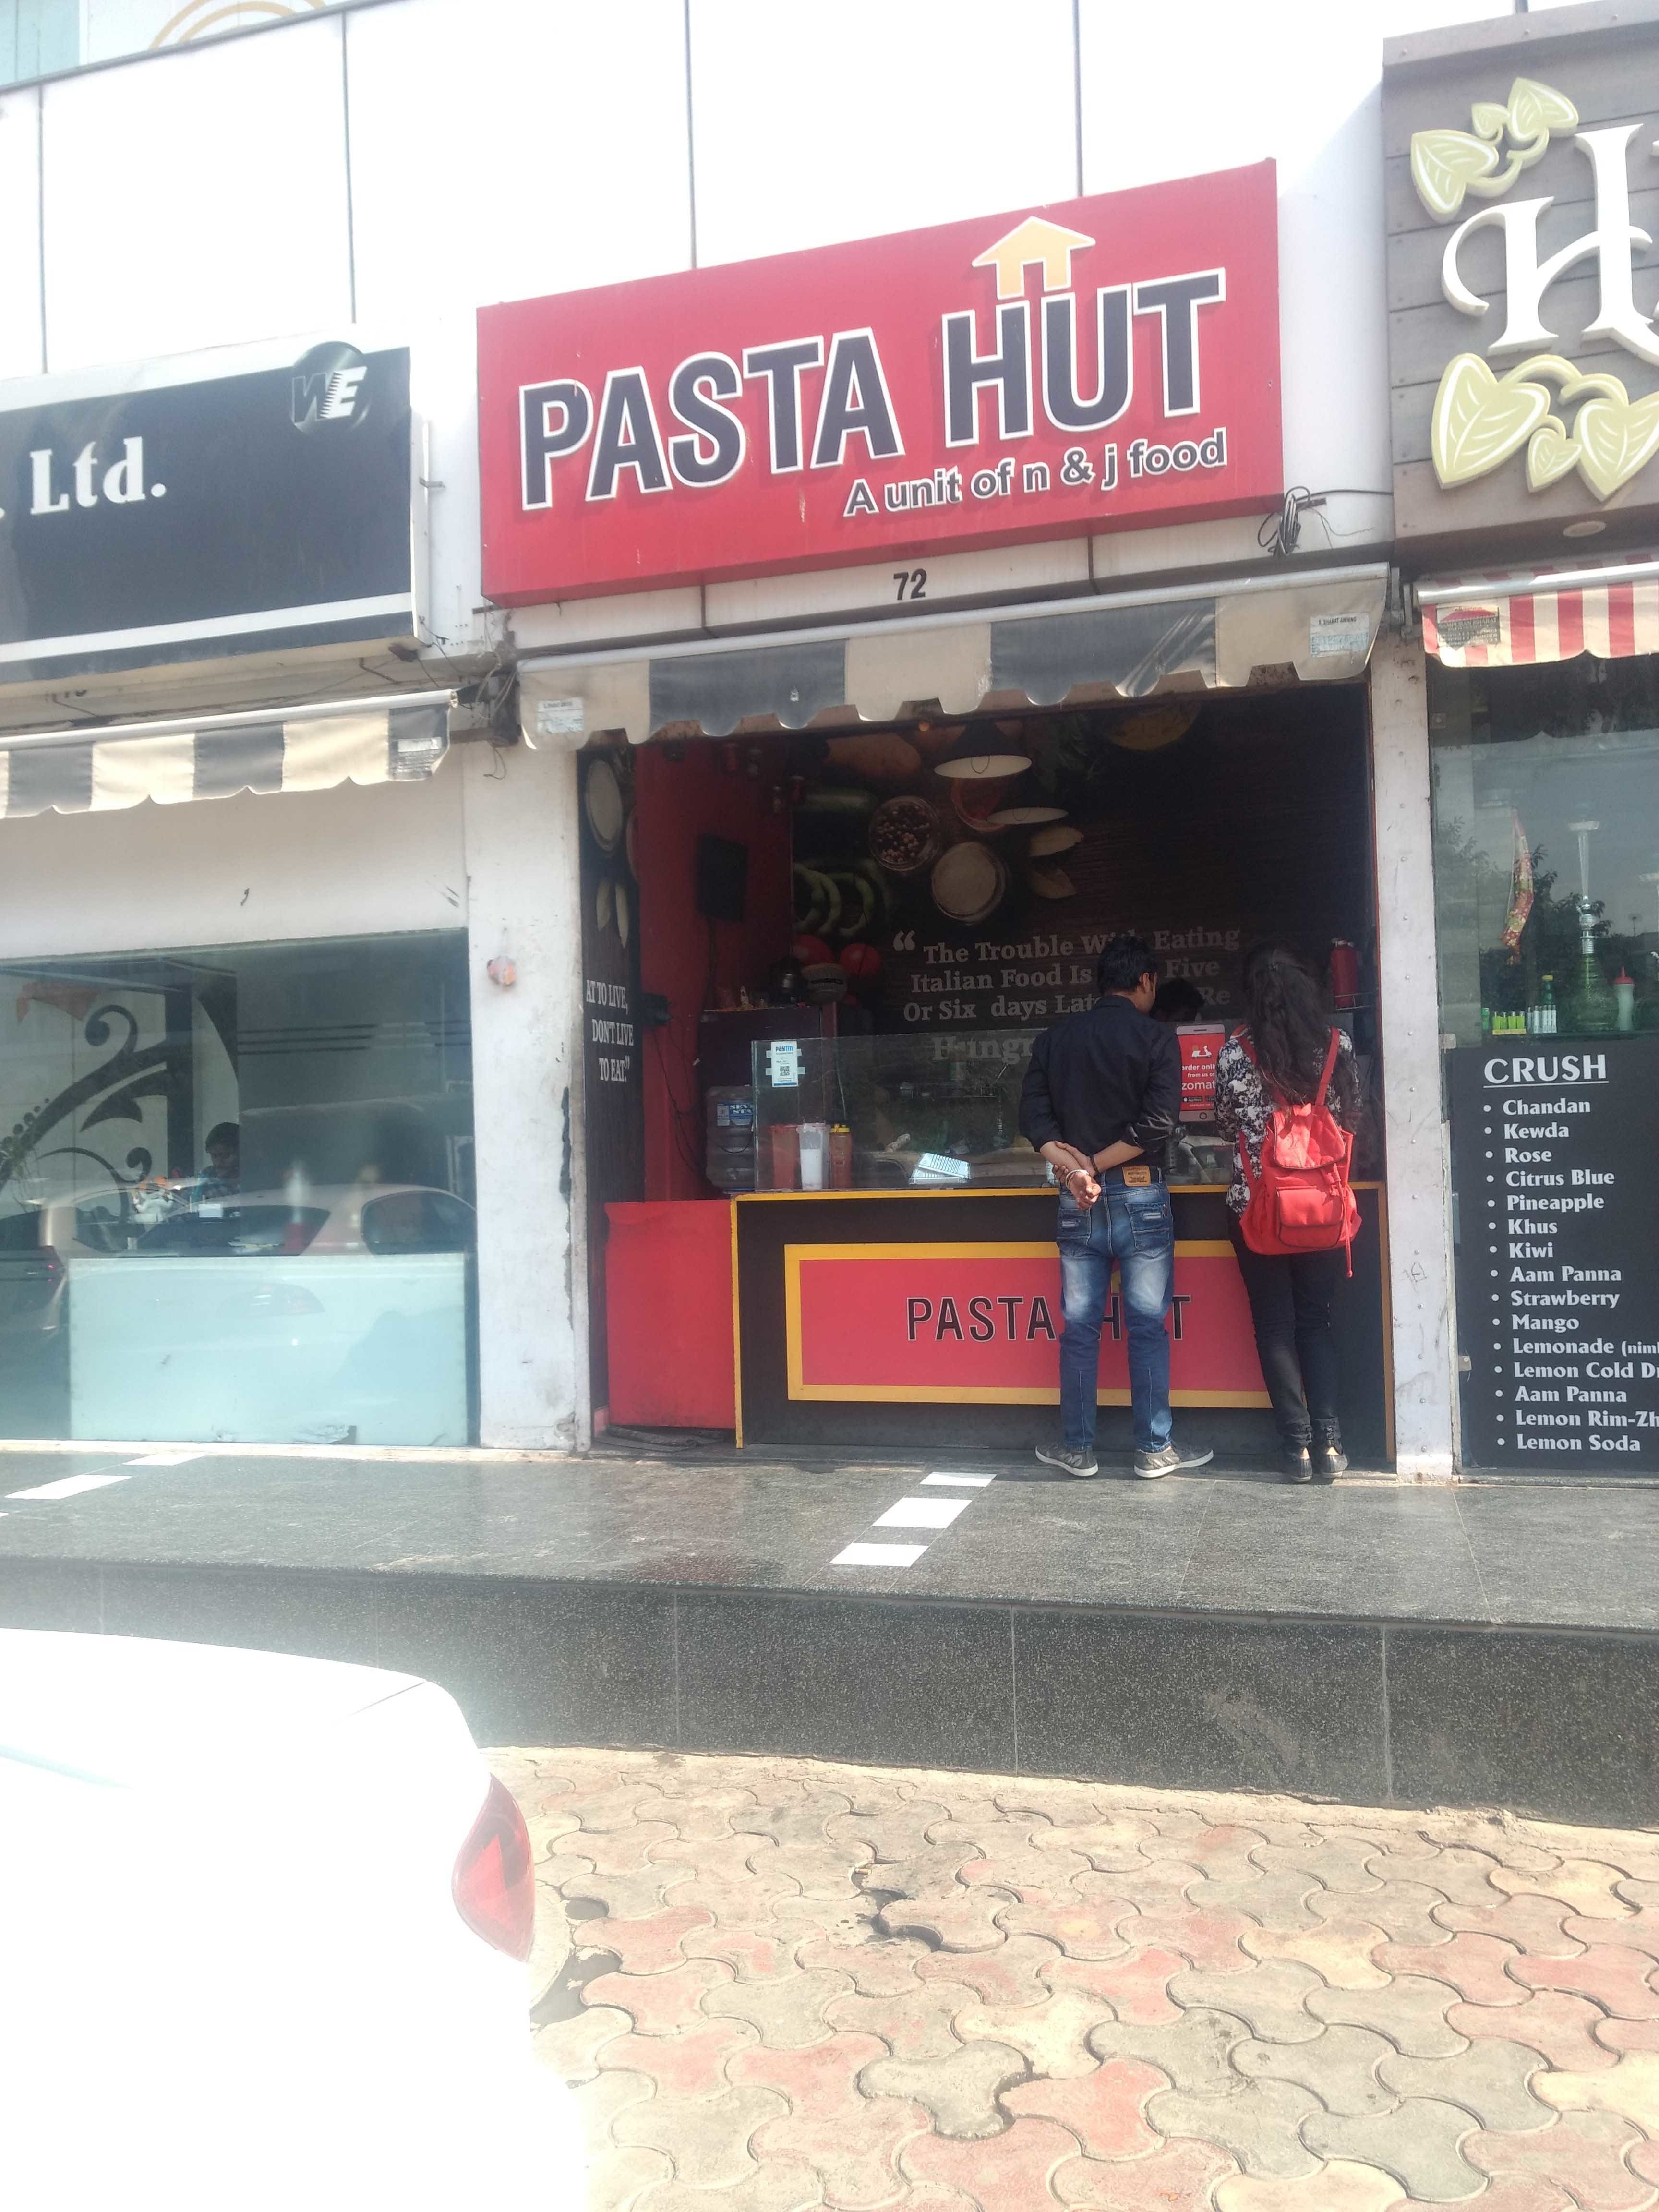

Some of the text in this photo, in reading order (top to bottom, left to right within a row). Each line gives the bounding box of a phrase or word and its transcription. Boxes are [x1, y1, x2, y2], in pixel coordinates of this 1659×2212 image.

[1443, 124, 1659, 365] H
[519, 267, 1226, 511] PASTA HUT
[30, 436, 167, 515] Ltd.
[843, 427, 1227, 517] A unit of n & j food
[893, 568, 927, 600] 72
[923, 942, 969, 964] The
[975, 934, 1073, 961] Trouble
[1153, 927, 1240, 951] Eating
[911, 959, 1220, 993] Italian Food Is Five
[586, 979, 596, 1003] AT
[597, 982, 607, 1006] TO
[904, 1003, 933, 1022] Or
[939, 999, 976, 1020] Six
[990, 995, 1047, 1022] days
[616, 1023, 634, 1046] LIVE
[932, 1035, 1036, 1065] Hungr
[599, 1058, 610, 1081] TO
[1484, 1054, 1607, 1083] CRUSH
[1182, 1080, 1215, 1090] zomat
[1503, 1098, 1591, 1115] Chandan
[1504, 1122, 1569, 1139] Kewda
[1505, 1147, 1552, 1163] Rose
[1506, 1169, 1615, 1187] Citrus Blue
[1507, 1193, 1604, 1213] Pineapple
[1508, 1218, 1558, 1234] Khus
[1509, 1242, 1553, 1258] Kiwi
[1510, 1266, 1622, 1282] Aam Panna
[1511, 1290, 1620, 1309] Strawberry
[907, 1295, 1191, 1342] PASTA HT
[1512, 1314, 1579, 1333] Mango
[1513, 1338, 1659, 1357] Lemonade (nim
[1514, 1362, 1659, 1378] Lemon Cold D
[1515, 1386, 1627, 1402] Aam Panna
[1515, 1410, 1581, 1426] Lemon
[1517, 1433, 1641, 1451] Lemon Soda
